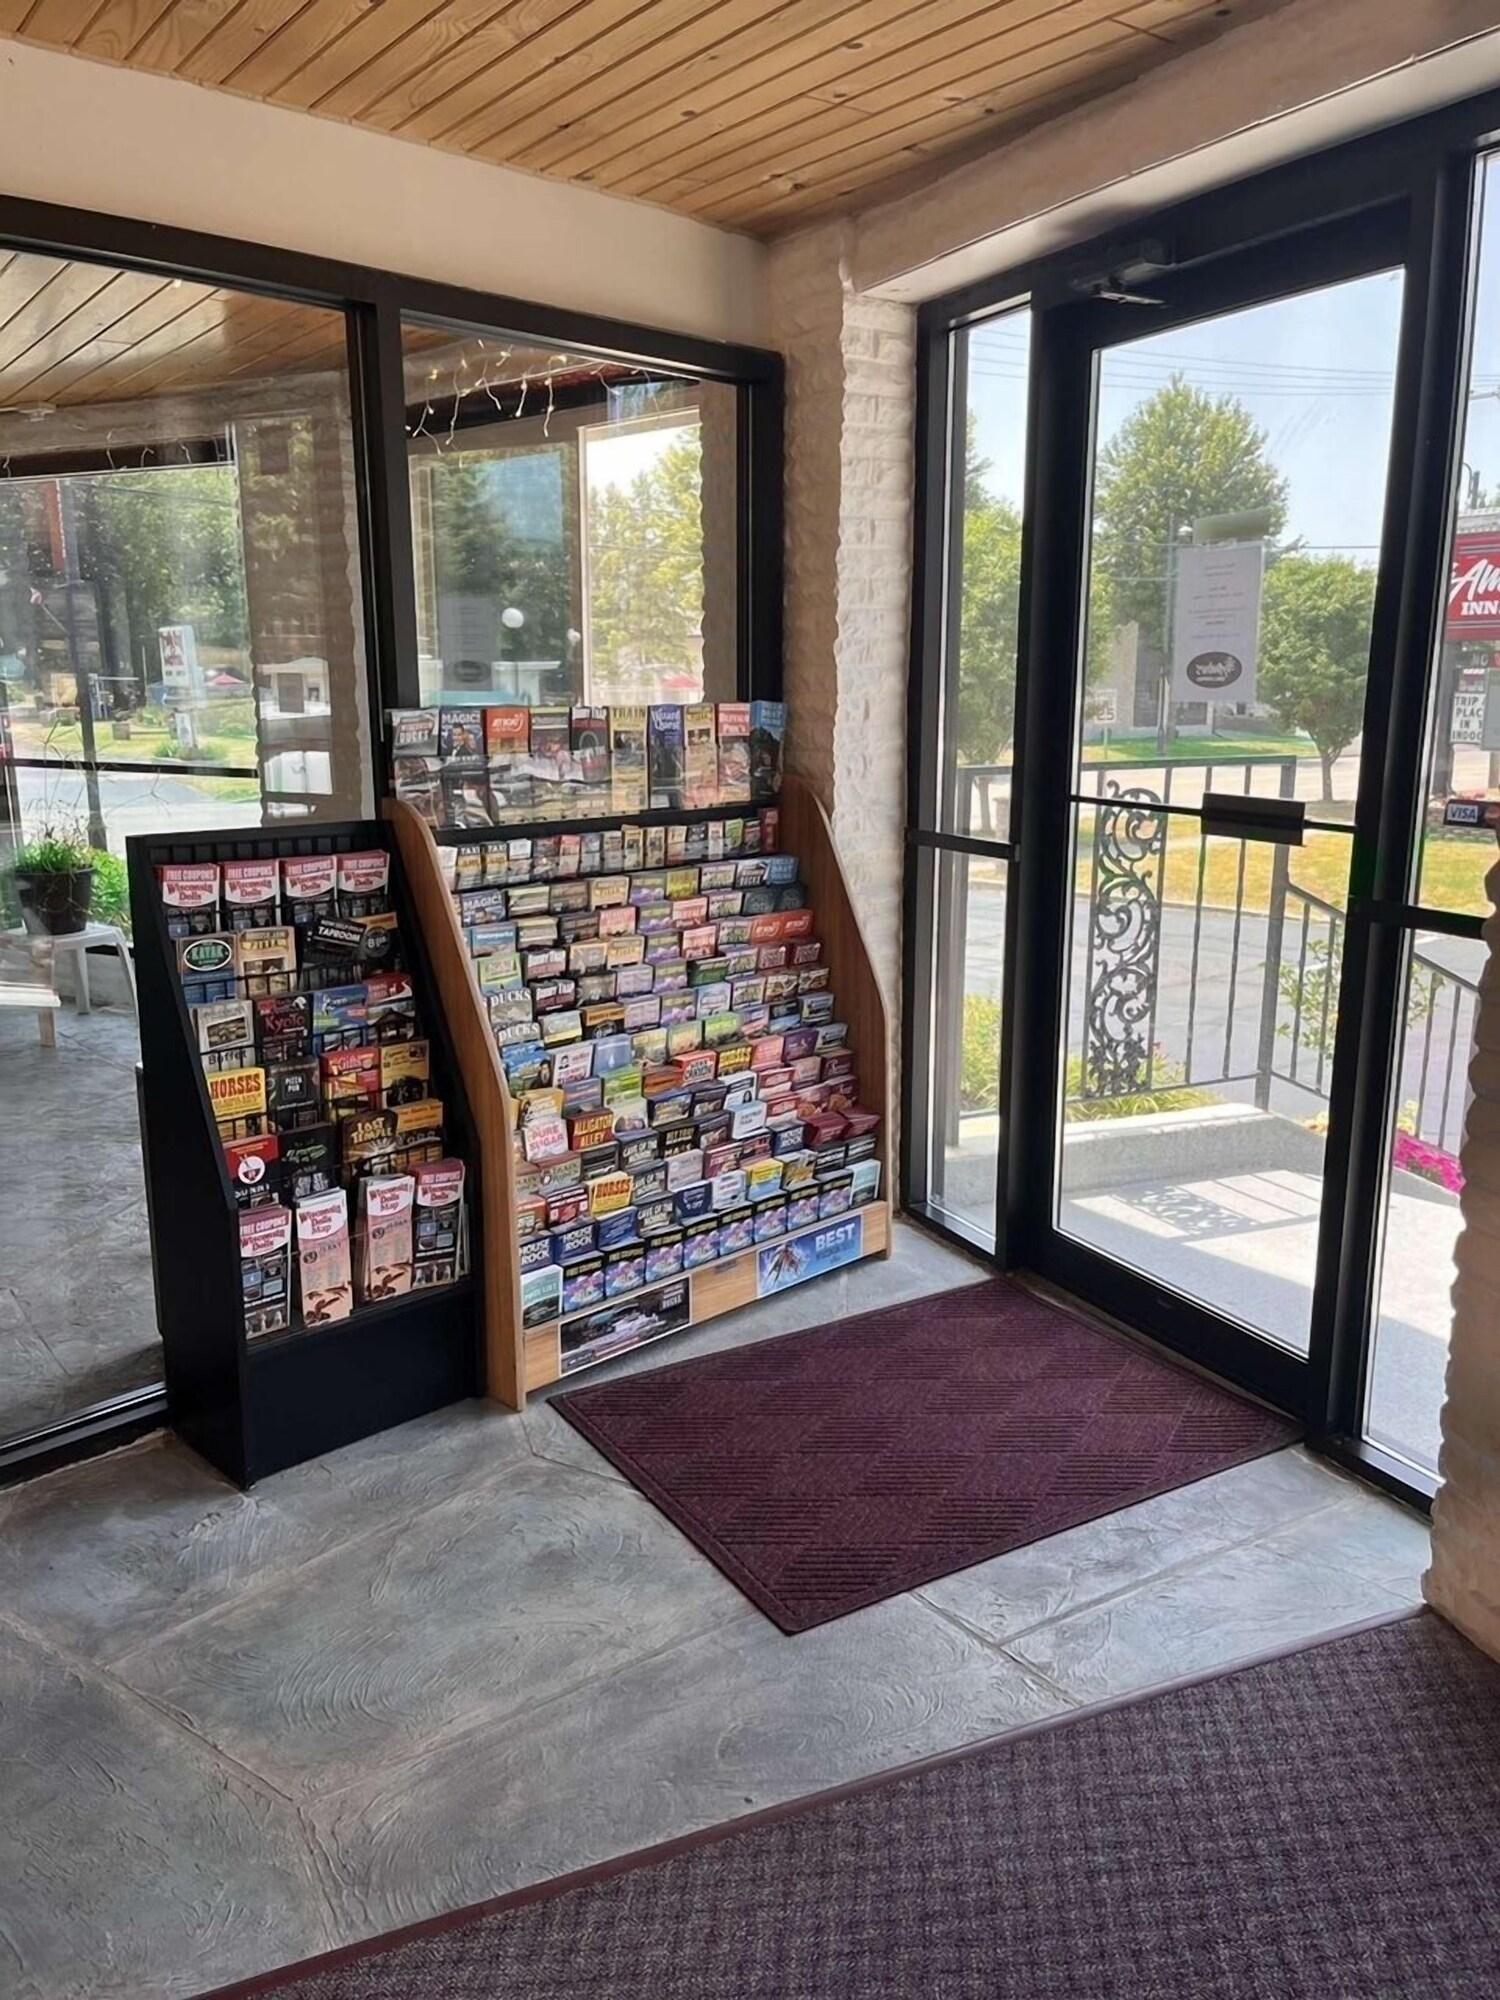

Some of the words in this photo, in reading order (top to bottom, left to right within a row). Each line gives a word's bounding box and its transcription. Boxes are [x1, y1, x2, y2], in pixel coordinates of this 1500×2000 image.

[441, 713, 480, 725] MAGIC!
[1450, 805, 1476, 820] VISA
[289, 872, 331, 888] Wisconsin
[344, 870, 383, 881] Wisconsin
[354, 879, 373, 887] Dells
[167, 883, 213, 895] Wisconsin
[229, 880, 272, 893] Wisconsin
[240, 888, 262, 897] Dells
[301, 882, 321, 891] Dells
[180, 891, 202, 900] Dells
[463, 896, 500, 909] MAGIC!
[318, 926, 361, 942] TAPROOM
[491, 988, 532, 1006] DUCKS
[499, 1022, 540, 1042] DUCKS
[210, 1073, 261, 1099] HORSES
[357, 1116, 385, 1133] LOST
[533, 1124, 560, 1140] PURE
[574, 1114, 613, 1135] ALLIGATOR
[351, 1127, 393, 1144] TEMPLE
[529, 1133, 564, 1152] SUGAR
[580, 1130, 608, 1148] ALLEY
[369, 1183, 409, 1201] Wisconsin
[421, 1183, 459, 1198] Wisconsin
[431, 1191, 449, 1200] Dells
[595, 1177, 632, 1199] HORSES
[299, 1204, 342, 1224] Wisconsin
[380, 1201, 400, 1212] Map
[312, 1215, 333, 1226] Dells
[311, 1224, 332, 1235] Map
[815, 1223, 856, 1251] BEST
[241, 1229, 285, 1248] Wisconsin
[252, 1240, 274, 1251] Dells
[565, 1236, 593, 1252] ROCK
[519, 1238, 550, 1256] HOUSE
[521, 1251, 550, 1266] ROCK
